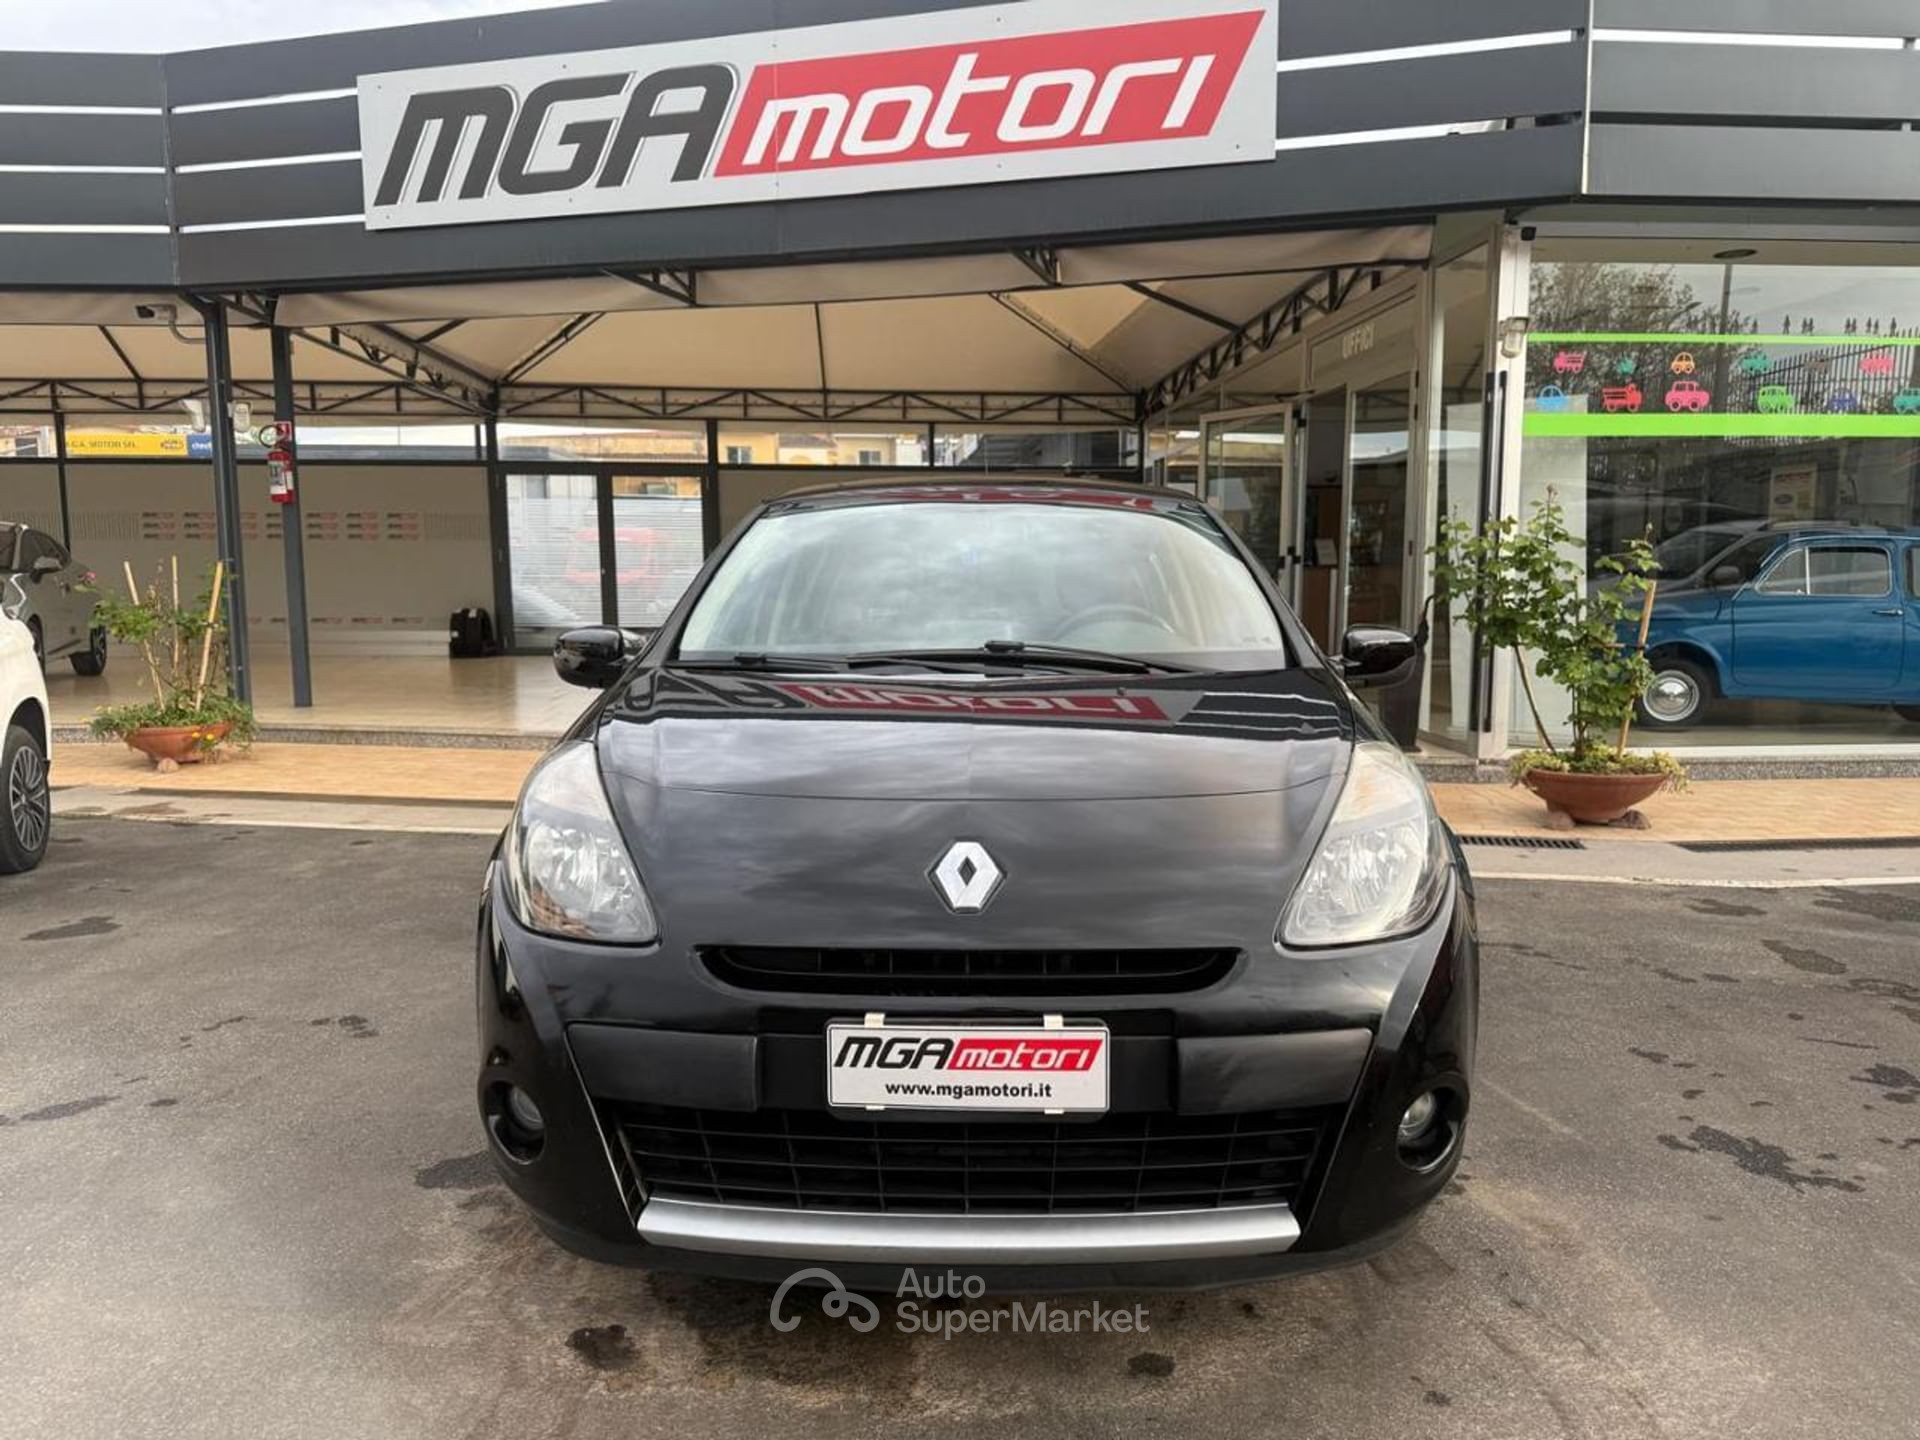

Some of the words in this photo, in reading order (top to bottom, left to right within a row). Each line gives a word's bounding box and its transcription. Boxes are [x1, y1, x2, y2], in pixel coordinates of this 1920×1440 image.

[374, 62, 741, 206] MGA
[743, 54, 1216, 166] motori
[834, 1036, 955, 1069] MGA
[957, 1042, 1092, 1070] motori
[886, 1082, 1052, 1100] www.mgamotori.it
